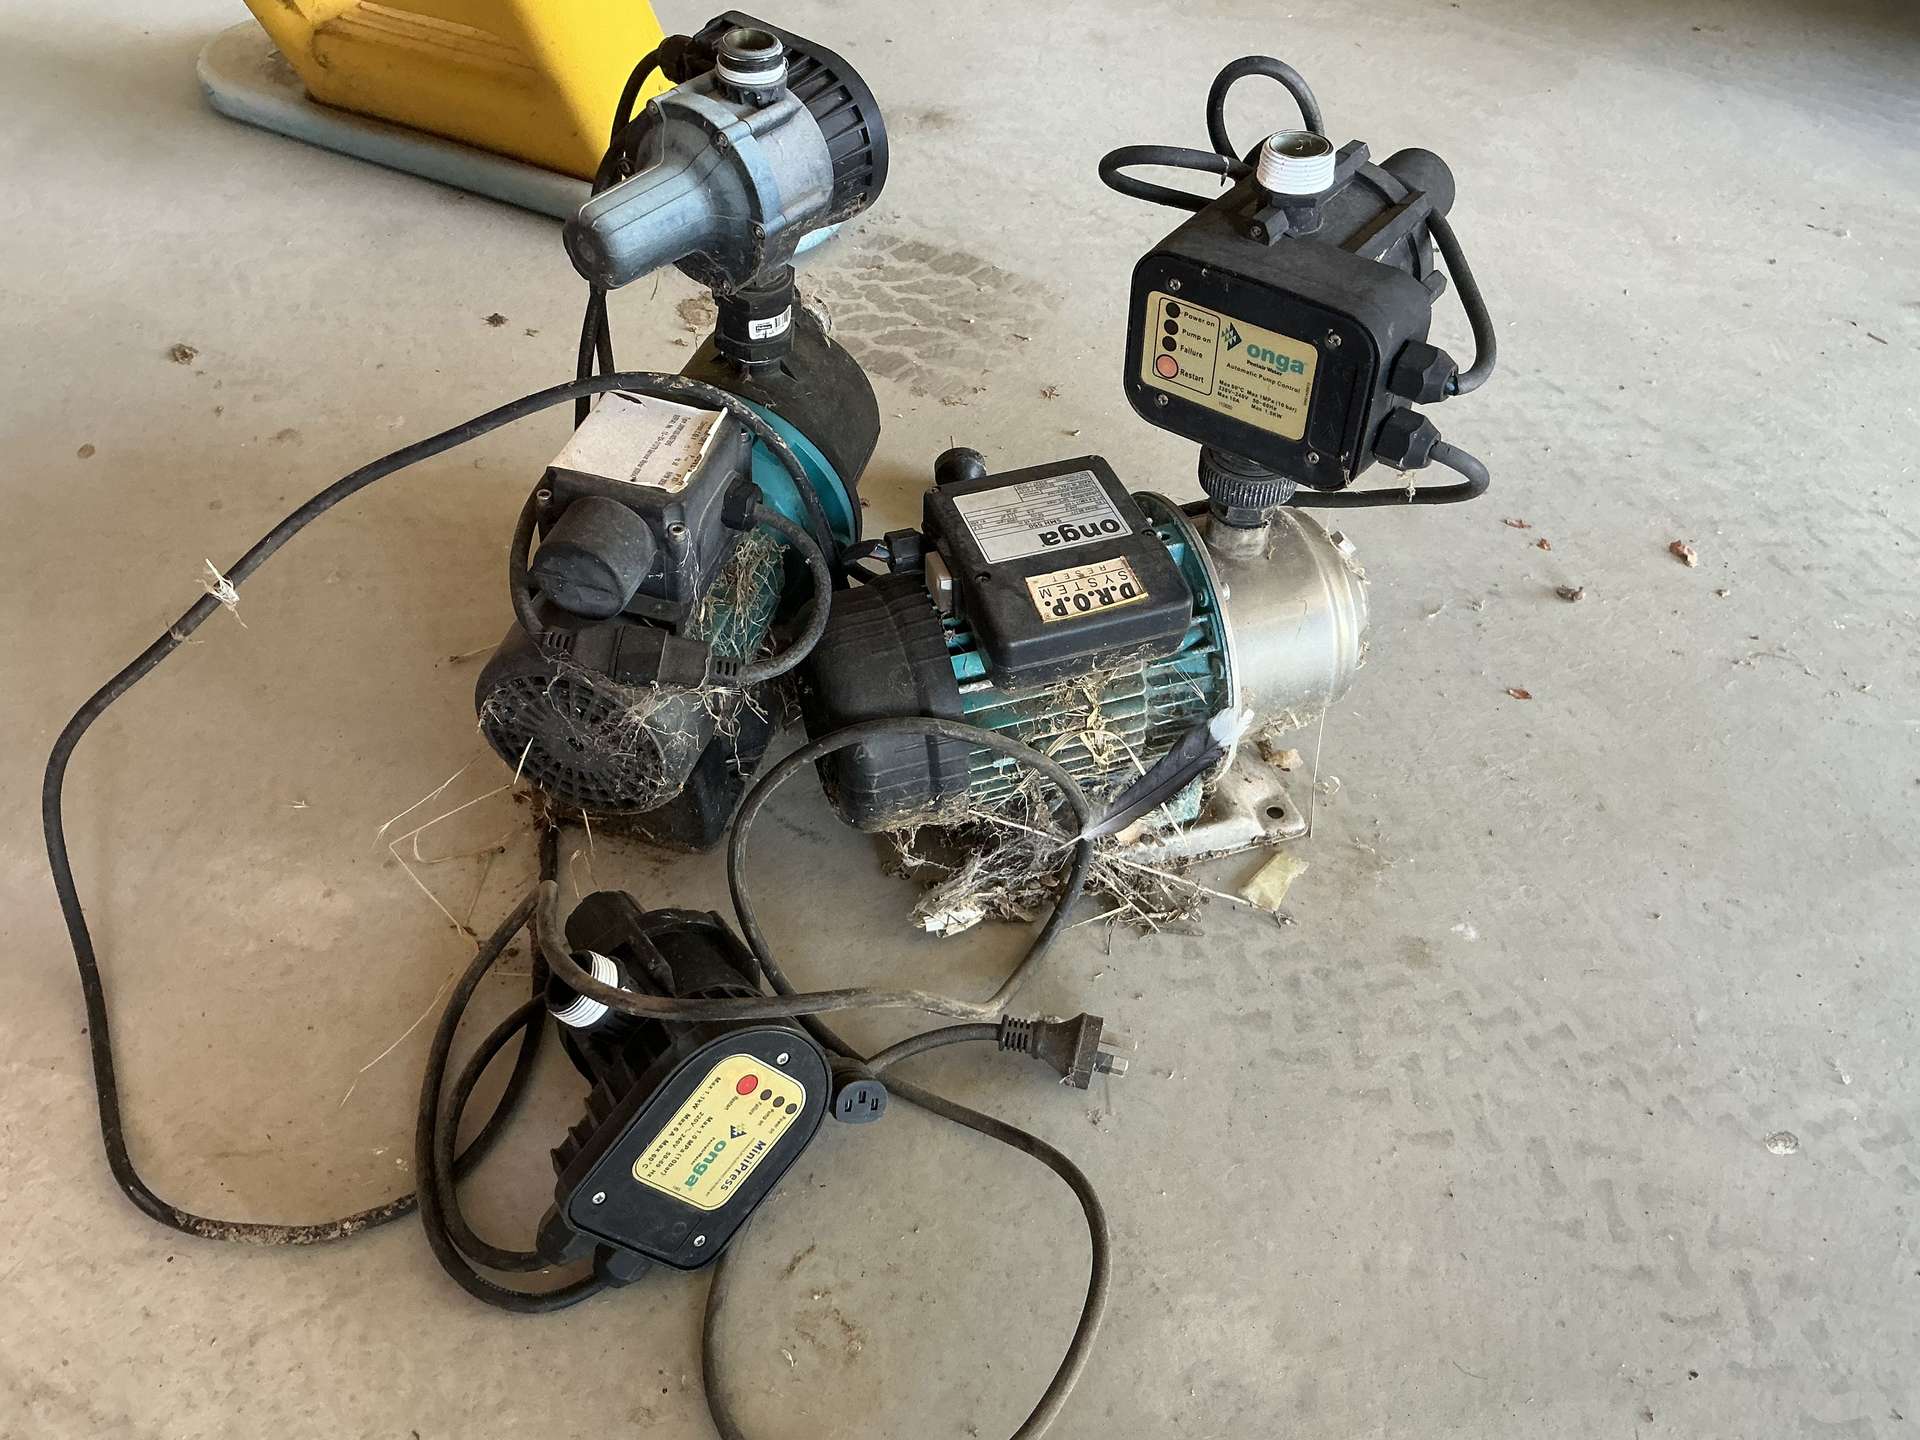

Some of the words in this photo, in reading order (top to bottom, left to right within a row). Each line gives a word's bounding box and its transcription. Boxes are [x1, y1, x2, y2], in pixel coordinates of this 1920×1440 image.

[1183, 311, 1205, 324] Power
[1182, 328, 1201, 341] Pump
[1180, 345, 1202, 358] Failure
[1246, 345, 1303, 375] onga
[1180, 368, 1204, 383] Restart
[1226, 362, 1257, 378] Automatic
[1258, 373, 1276, 386] Pump
[1276, 380, 1300, 393] Control
[1037, 516, 1121, 547] onga
[1038, 570, 1128, 598] SYSTEM
[1052, 564, 1106, 581] RESET
[1044, 582, 1136, 618] D.R.O.P.
[681, 1137, 729, 1188] onga
[719, 1139, 766, 1192] MiniPress
